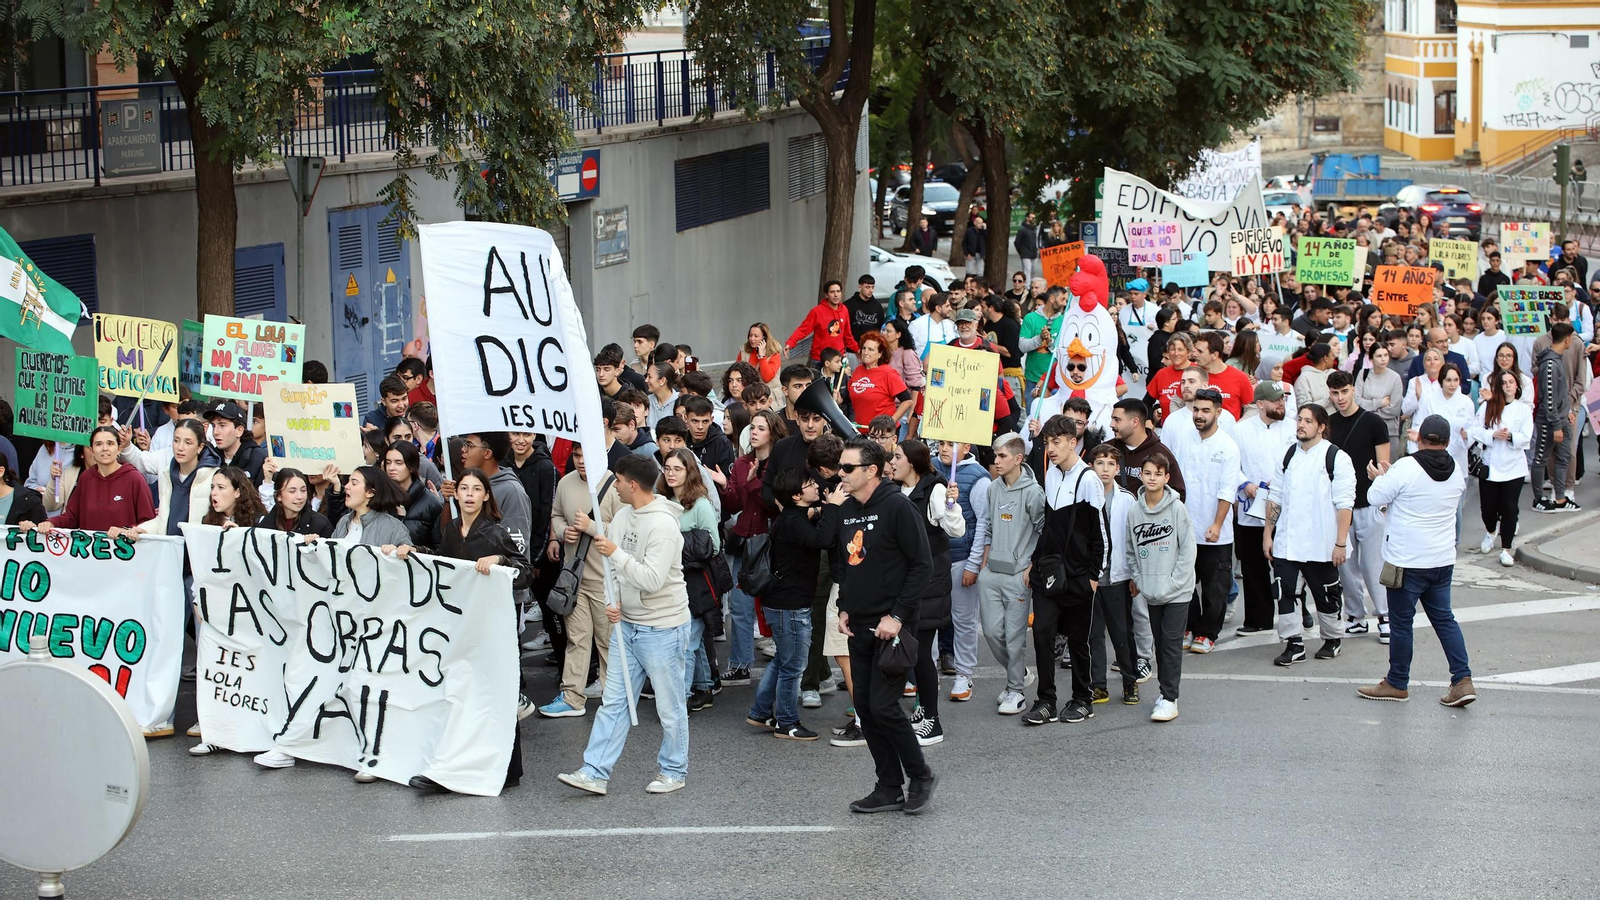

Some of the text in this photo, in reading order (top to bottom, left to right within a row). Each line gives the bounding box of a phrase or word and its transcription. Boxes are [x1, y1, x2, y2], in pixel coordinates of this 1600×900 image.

[123, 105, 138, 129] P
[107, 133, 157, 146] APARCAMIENTO
[121, 149, 145, 158] PARKING
[1159, 236, 1172, 246] NO
[1246, 239, 1283, 255] NUEVO
[1304, 240, 1354, 256] 14 AÑOS
[1310, 260, 1343, 268] FALSAS
[1300, 270, 1349, 282] PROMESAS
[1382, 267, 1434, 286] 14 AÑOS
[1377, 290, 1409, 302] ENTRE
[226, 322, 286, 343] EL LOLA
[117, 346, 144, 371] MI
[234, 340, 276, 358] FLORES
[1268, 344, 1289, 352] AMPA
[21, 351, 70, 374] QUEREMOS
[211, 349, 251, 372] NO SE
[18, 371, 36, 389] QUE
[40, 374, 48, 391] SE
[35, 392, 71, 413] LA LEY
[502, 405, 536, 428] IES
[1132, 522, 1174, 546] Future
[212, 527, 463, 615] INICIO DE
[306, 600, 451, 688] OBRAS
[215, 646, 256, 672] IES
[204, 668, 242, 691] LOLA
[214, 686, 269, 715] FLORES
